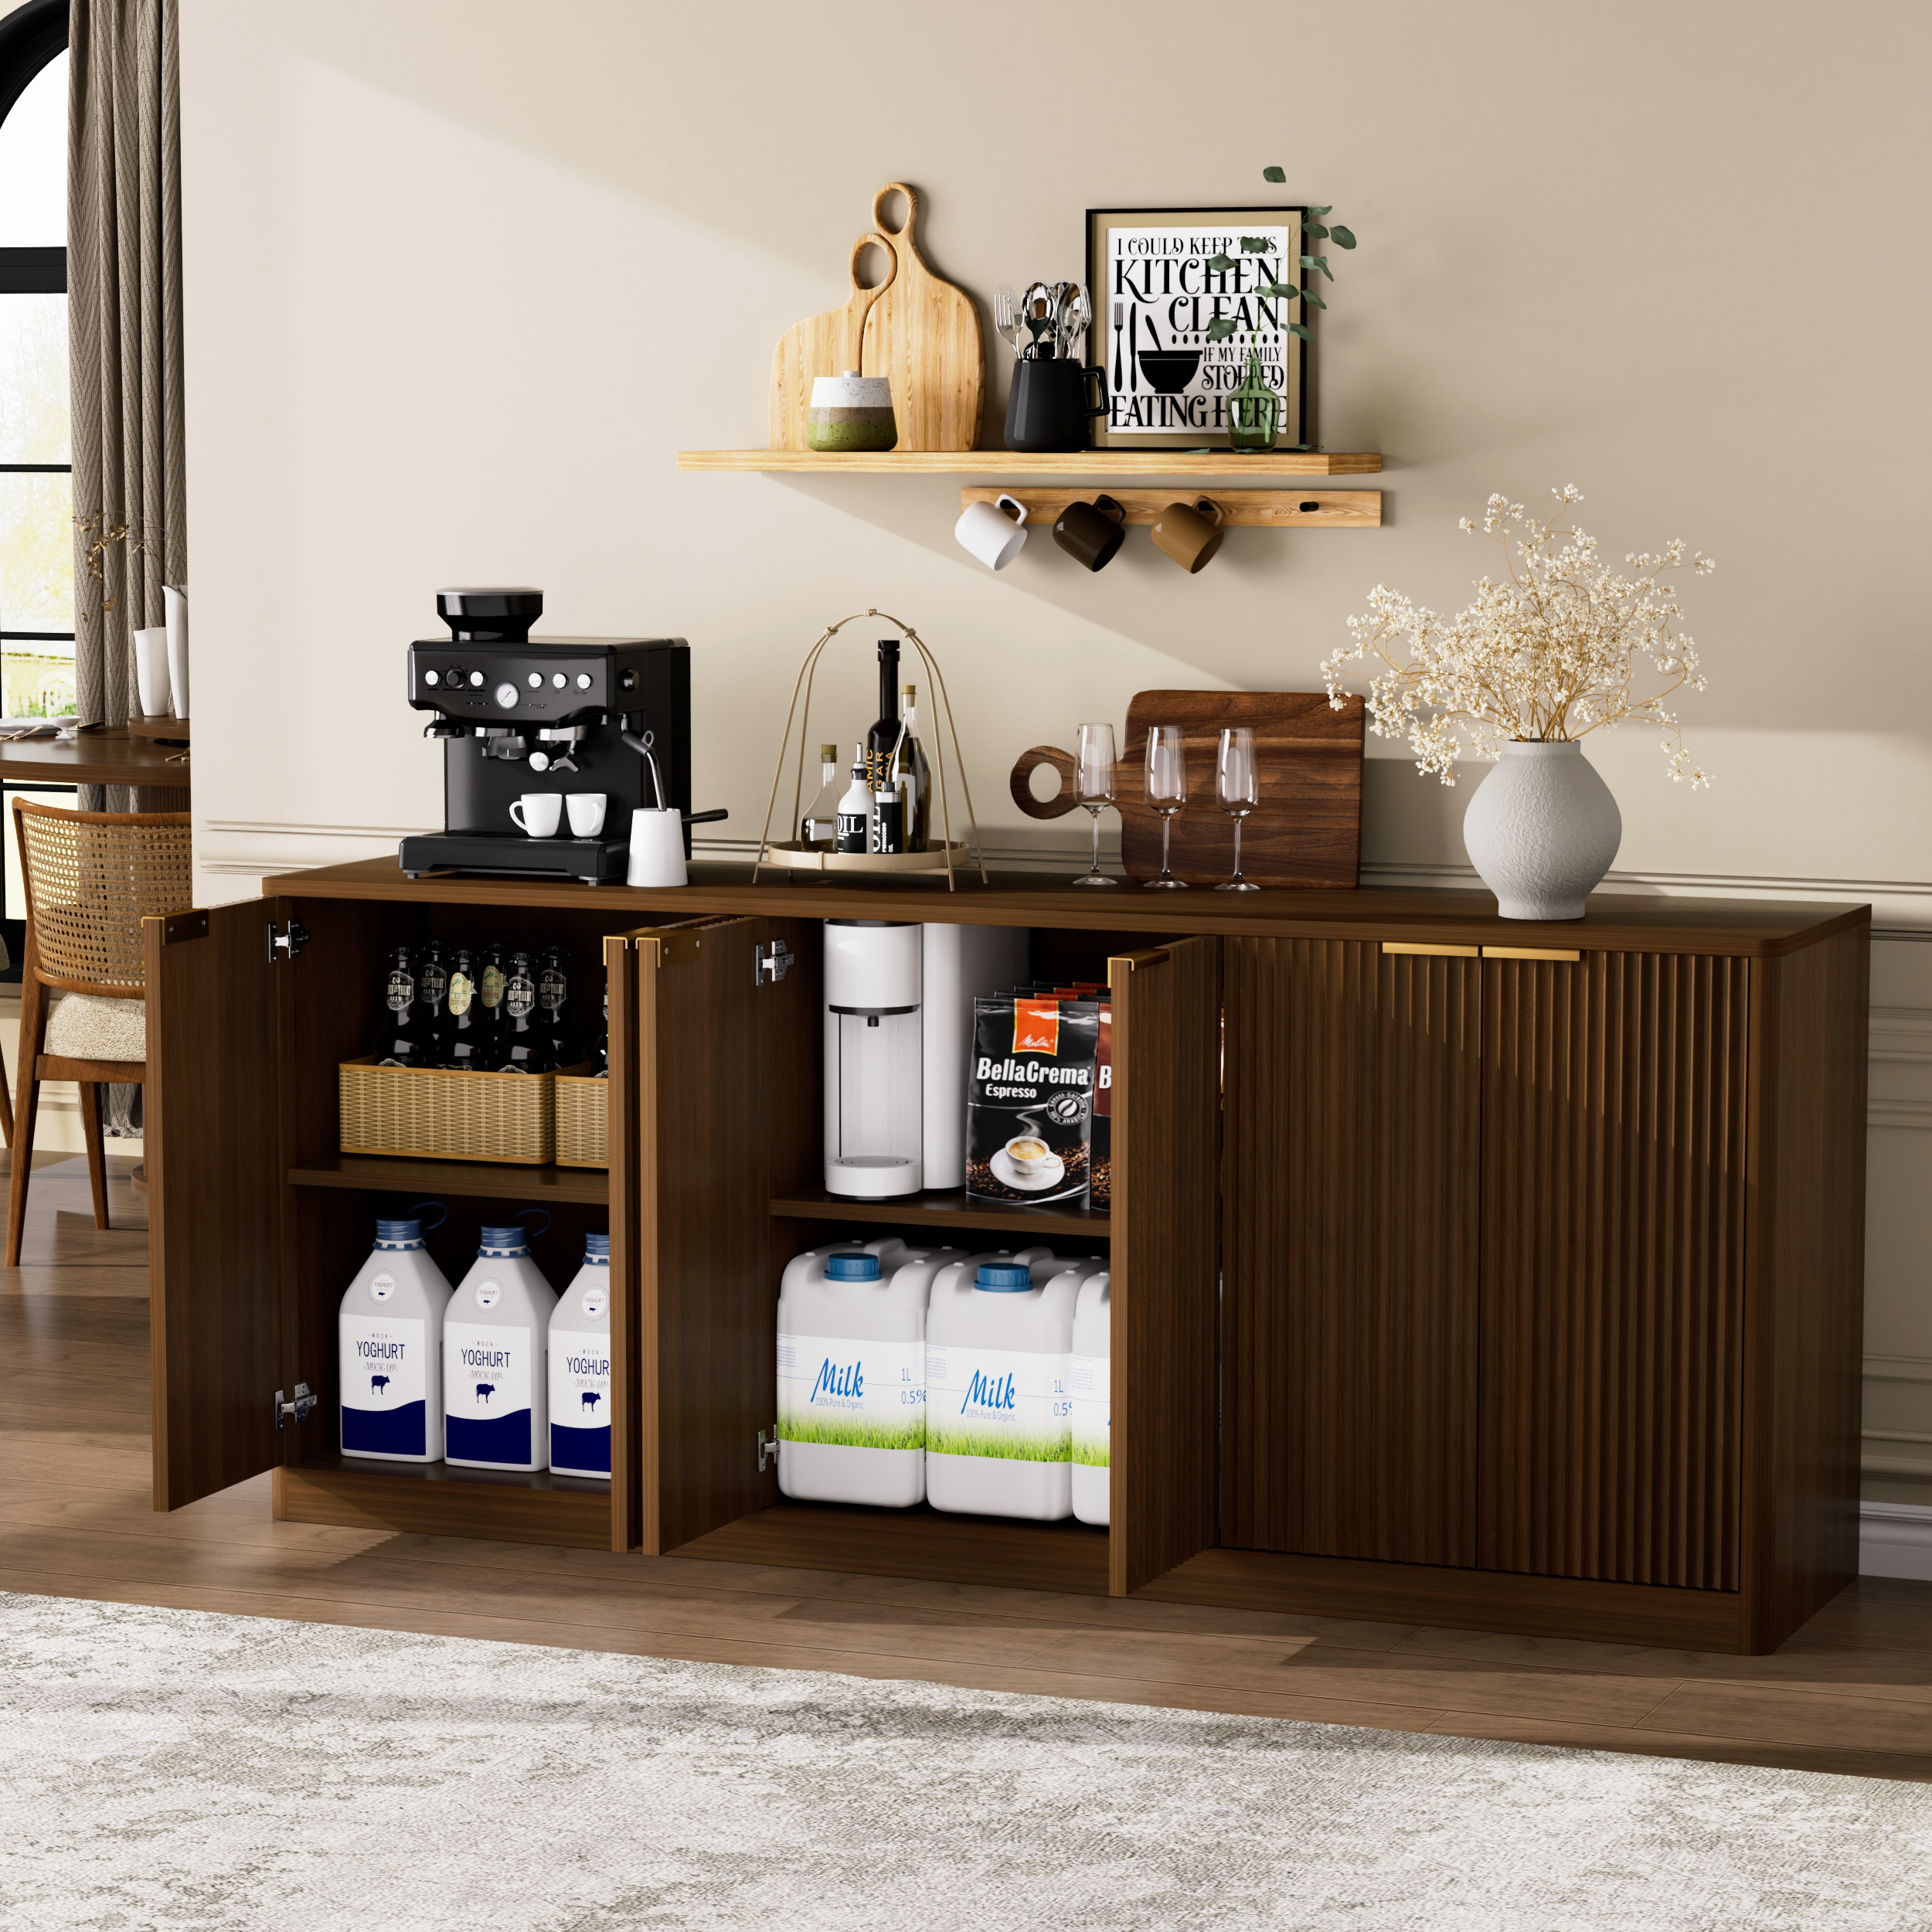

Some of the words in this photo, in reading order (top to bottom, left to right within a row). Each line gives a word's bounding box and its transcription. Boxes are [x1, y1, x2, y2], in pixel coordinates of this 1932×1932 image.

[1117, 238, 1122, 255] I
[1128, 237, 1184, 255] COULD
[1190, 237, 1233, 255] KEEP
[1114, 258, 1281, 303] KITCHEN
[1168, 296, 1279, 332] CLEAN
[1204, 347, 1215, 362] IF
[1219, 347, 1236, 362] MY
[1240, 347, 1281, 362] FAMILY
[1202, 365, 1284, 389] STOPPED
[1110, 396, 1209, 427] EATING
[1210, 396, 1286, 427] HERE
[838, 815, 864, 833] OIL
[977, 1057, 1088, 1085] BellaCrema
[985, 1083, 1037, 1099] Espresso
[357, 1341, 405, 1359] YOGHURT
[461, 1349, 510, 1368] YOGHURT
[810, 1357, 864, 1403] Milk
[901, 1368, 910, 1381] 1L
[961, 1369, 1015, 1414] Milk
[1054, 1379, 1063, 1393] 1L
[816, 1397, 828, 1406] 100%
[830, 1398, 841, 1408] Pure
[842, 1399, 845, 1408] &
[847, 1400, 864, 1410] Organic
[901, 1389, 926, 1403] 0.5%
[967, 1409, 980, 1418] 100%
[980, 1410, 991, 1419] Pure
[997, 1411, 1015, 1422] Organic
